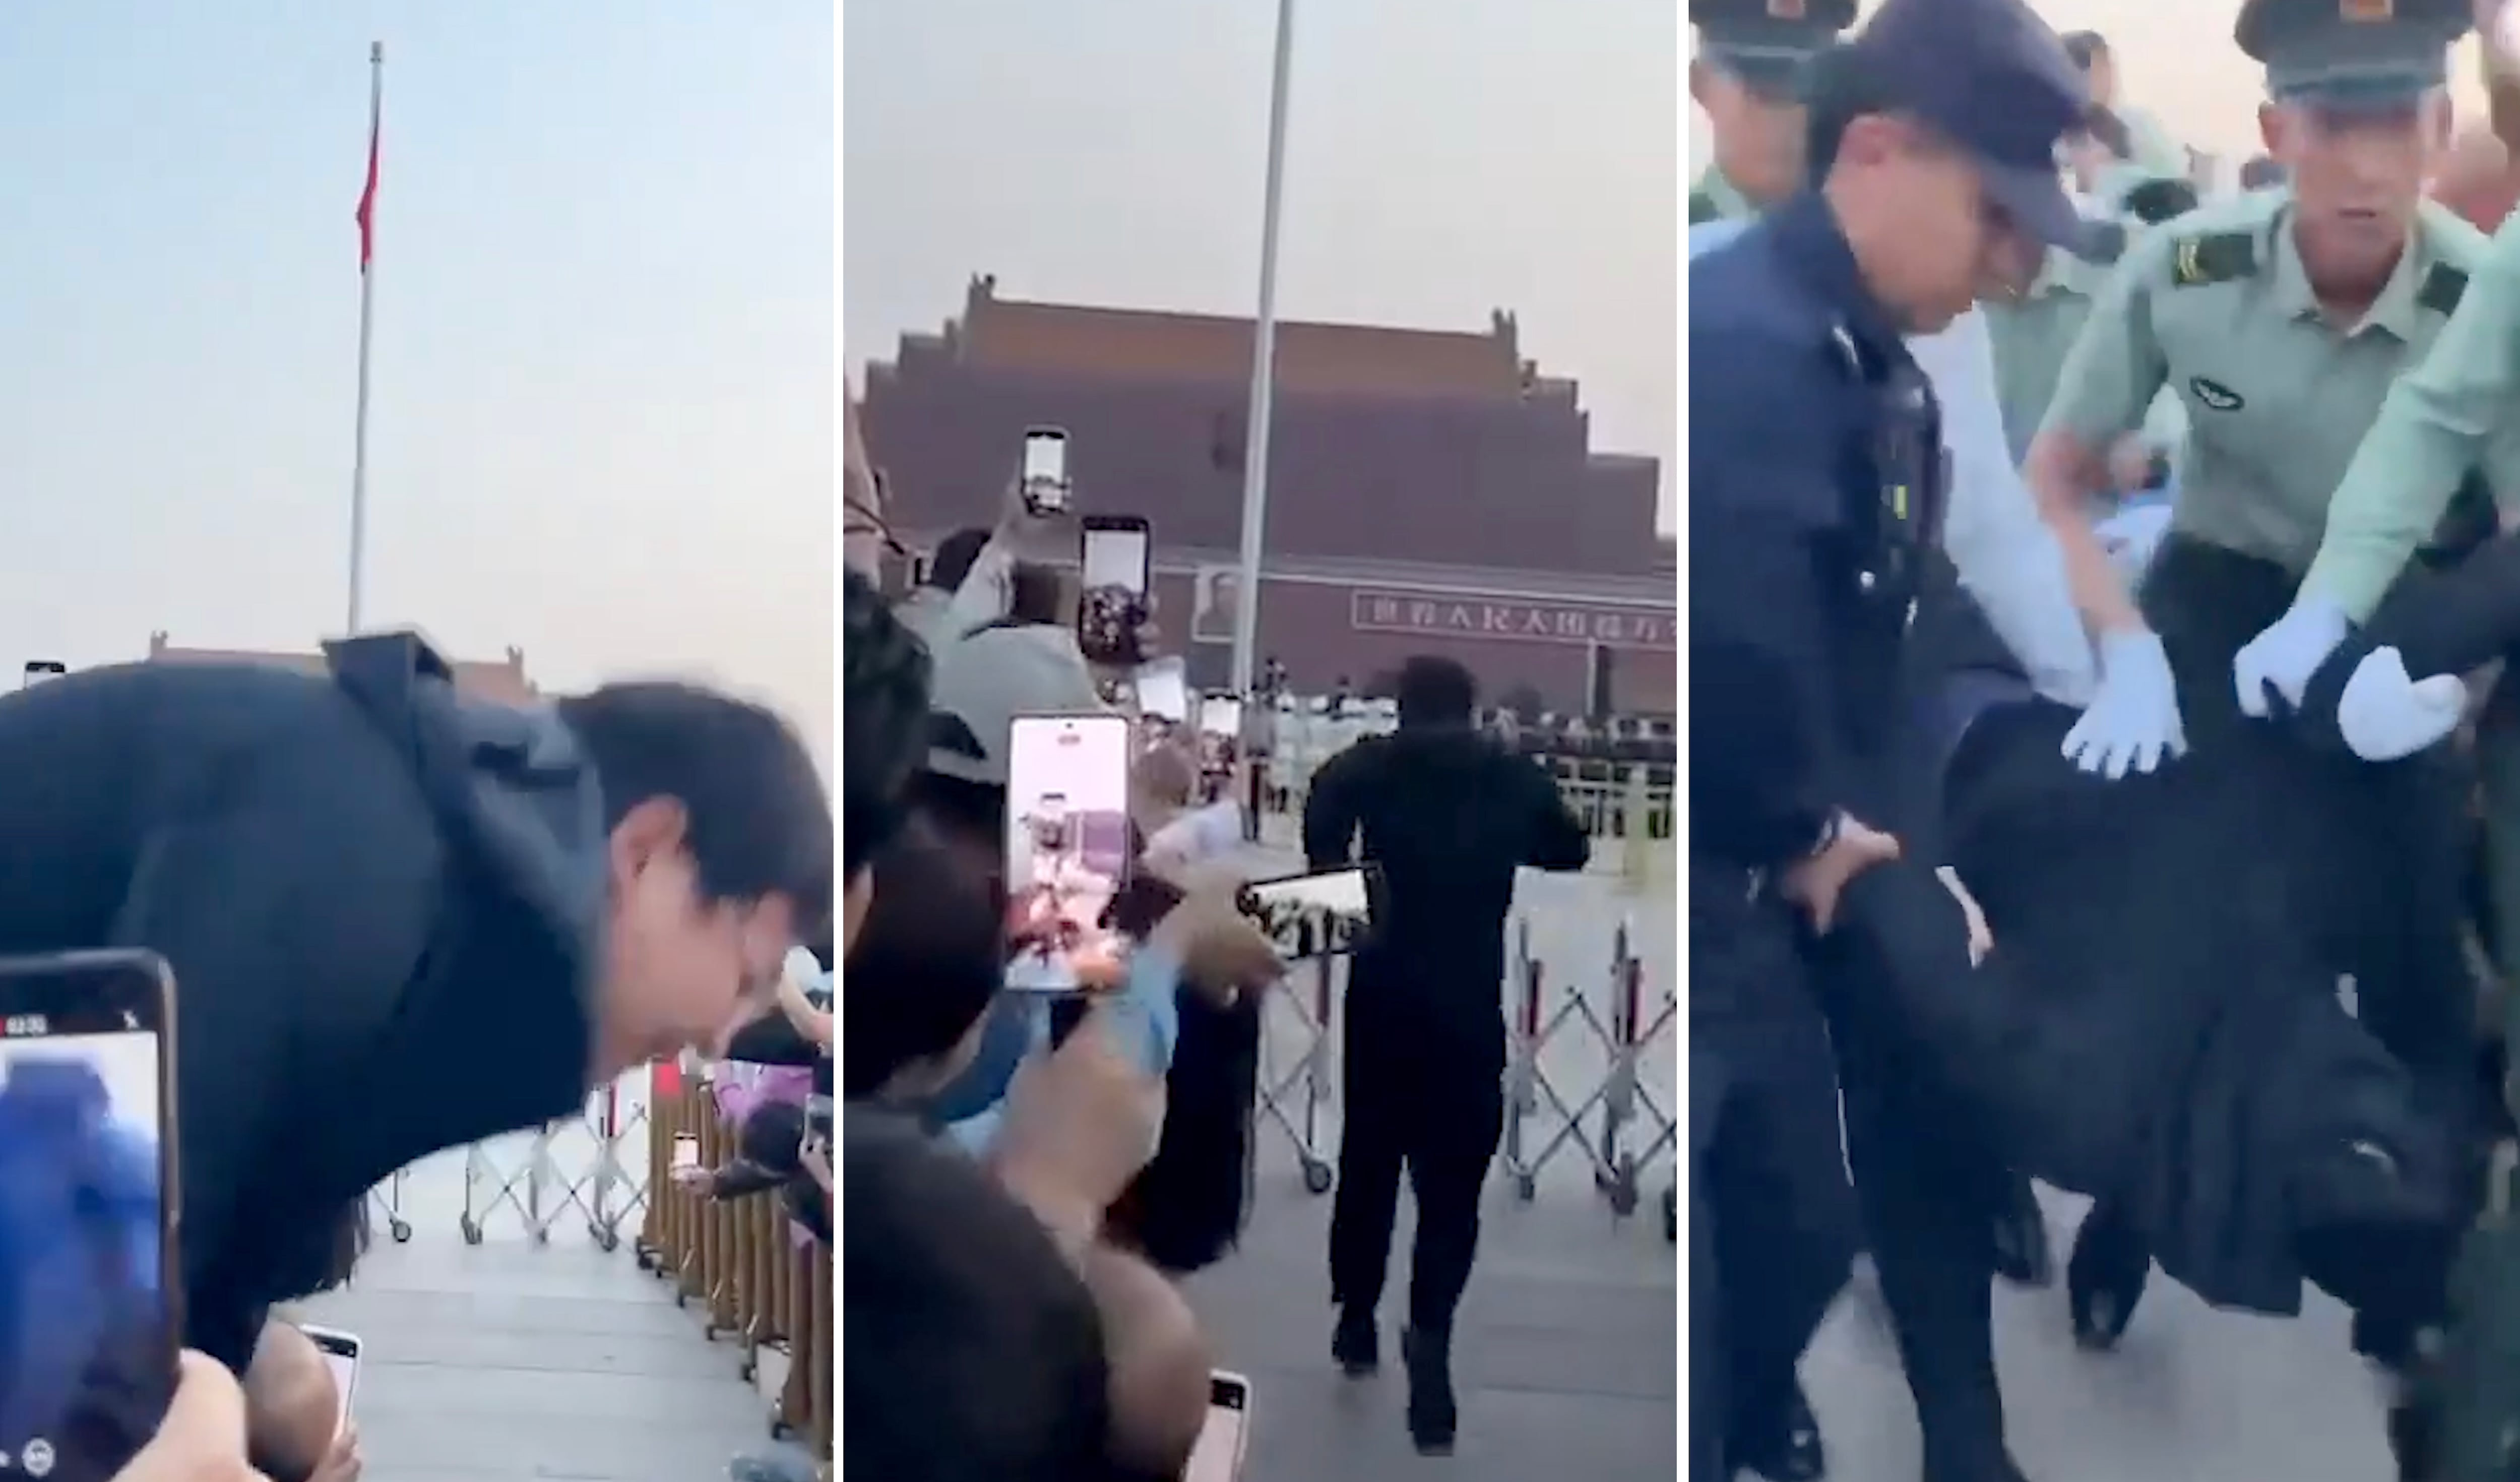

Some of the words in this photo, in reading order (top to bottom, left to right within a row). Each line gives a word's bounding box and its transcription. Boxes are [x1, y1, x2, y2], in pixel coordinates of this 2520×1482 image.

[1374, 597, 1676, 642] 世界人民大团结万
